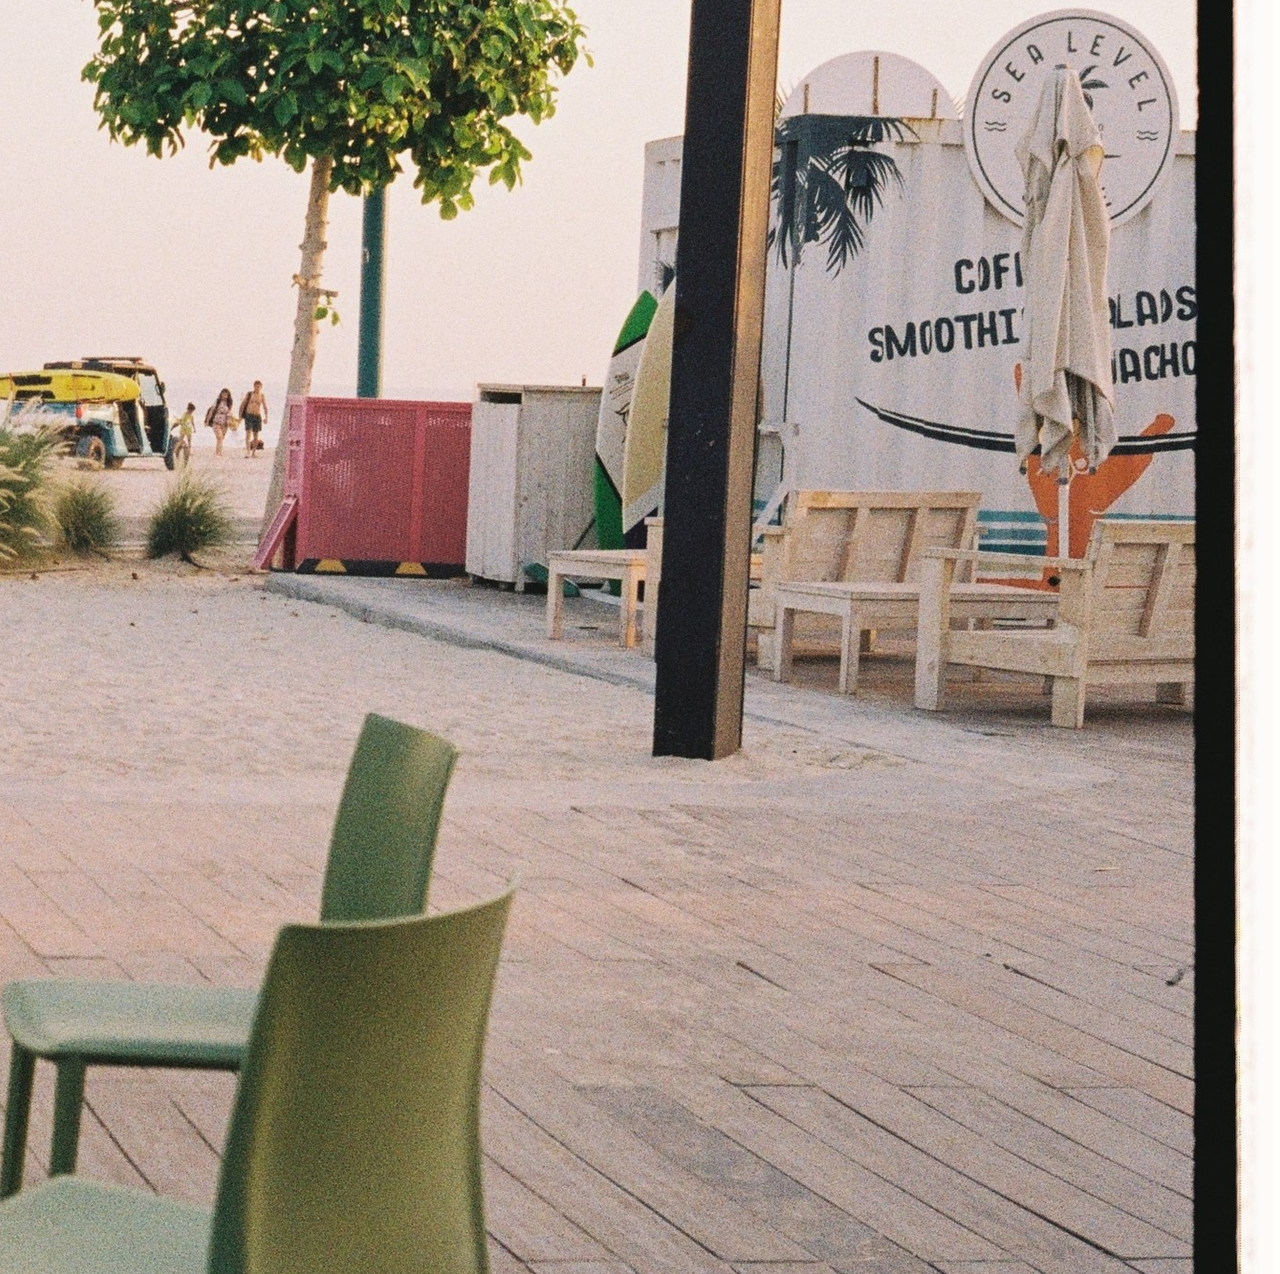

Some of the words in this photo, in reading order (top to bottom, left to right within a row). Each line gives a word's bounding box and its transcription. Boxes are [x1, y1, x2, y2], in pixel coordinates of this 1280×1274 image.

[991, 44, 1045, 104] SEA
[1067, 31, 1157, 112] LEVEL
[954, 251, 1023, 295] COF
[868, 307, 1024, 363] SMOOTHI
[1111, 340, 1197, 385] ACHO
